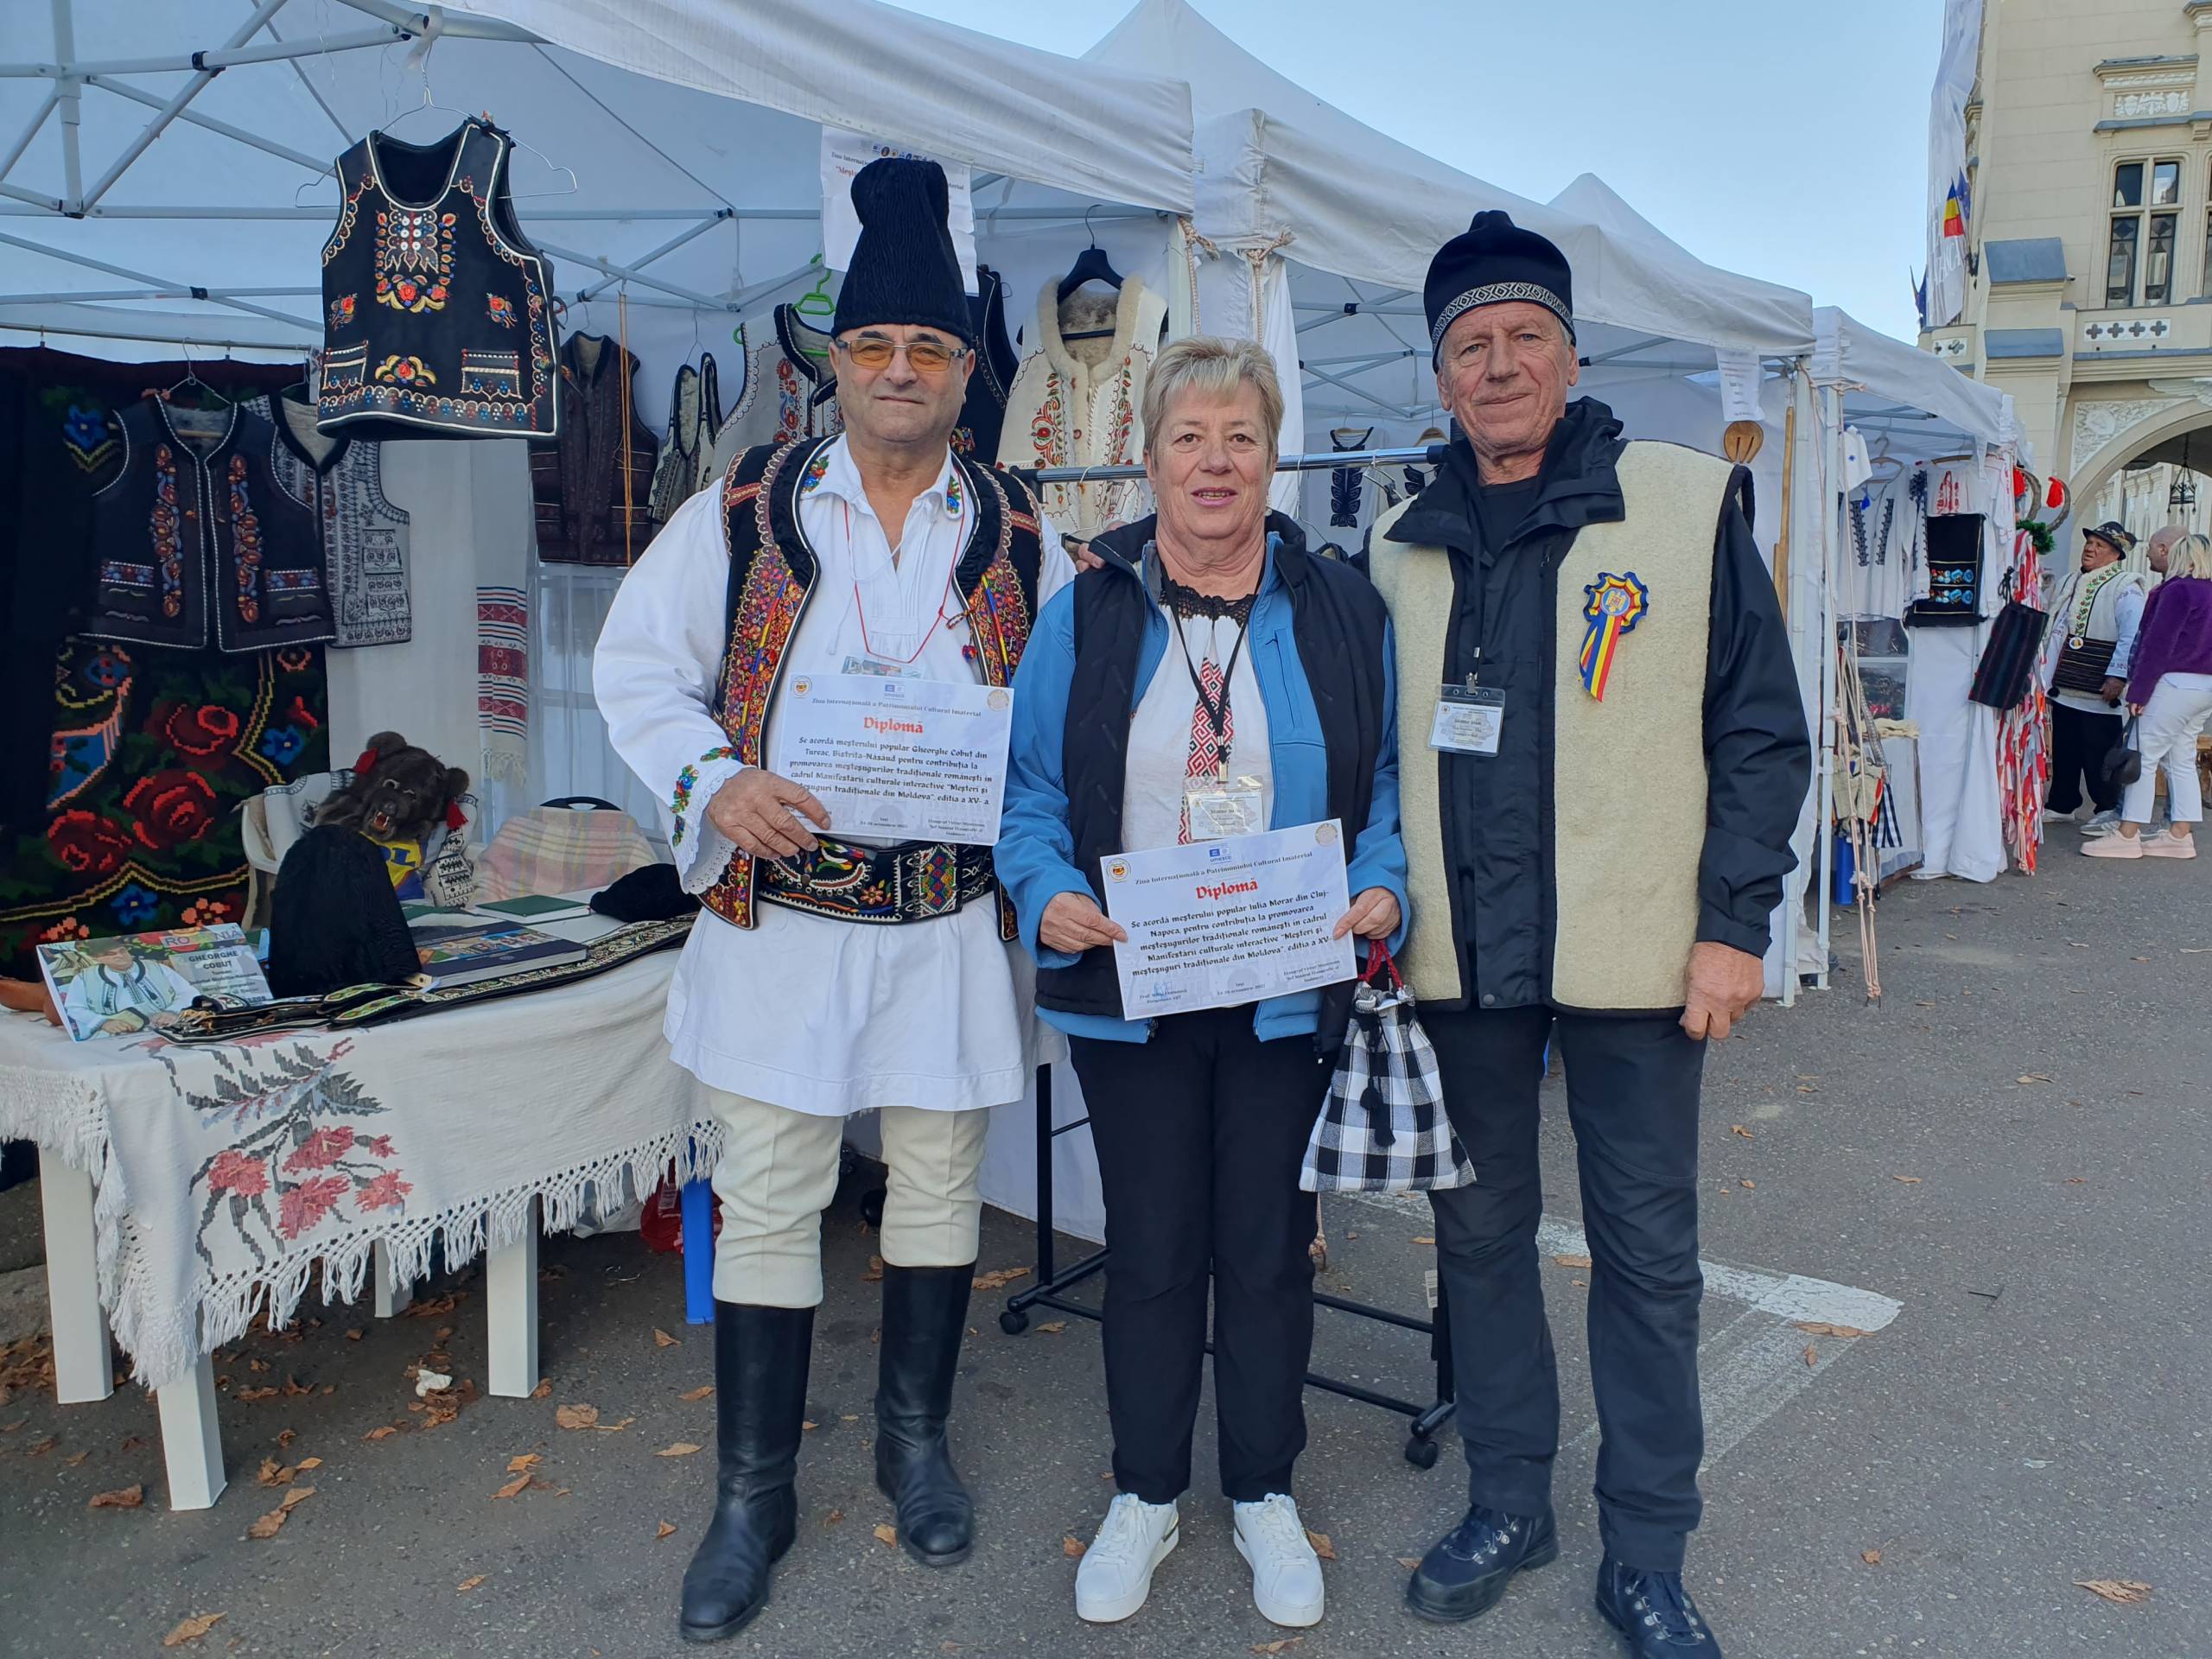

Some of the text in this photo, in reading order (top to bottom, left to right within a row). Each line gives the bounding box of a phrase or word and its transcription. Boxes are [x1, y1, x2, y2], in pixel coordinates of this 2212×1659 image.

[880, 742, 910, 752] popular
[912, 745, 949, 756] Gheorghe
[898, 756, 924, 765] pentru
[866, 777, 901, 785] culturale
[903, 780, 944, 790] interactive
[1282, 851, 1313, 861] Imaterial
[1217, 905, 1249, 918] popular
[1249, 901, 1268, 911] Iulia
[1268, 897, 1294, 906] Morar
[1295, 893, 1308, 902] din
[1183, 923, 1210, 934] pentru
[1268, 905, 1314, 921] promovarea
[1302, 912, 1327, 924] cadrul
[1198, 944, 1234, 955] culturale
[1236, 936, 1279, 949] interactive
[188, 950, 239, 963] GHEORGHE
[1232, 953, 1245, 962] din
